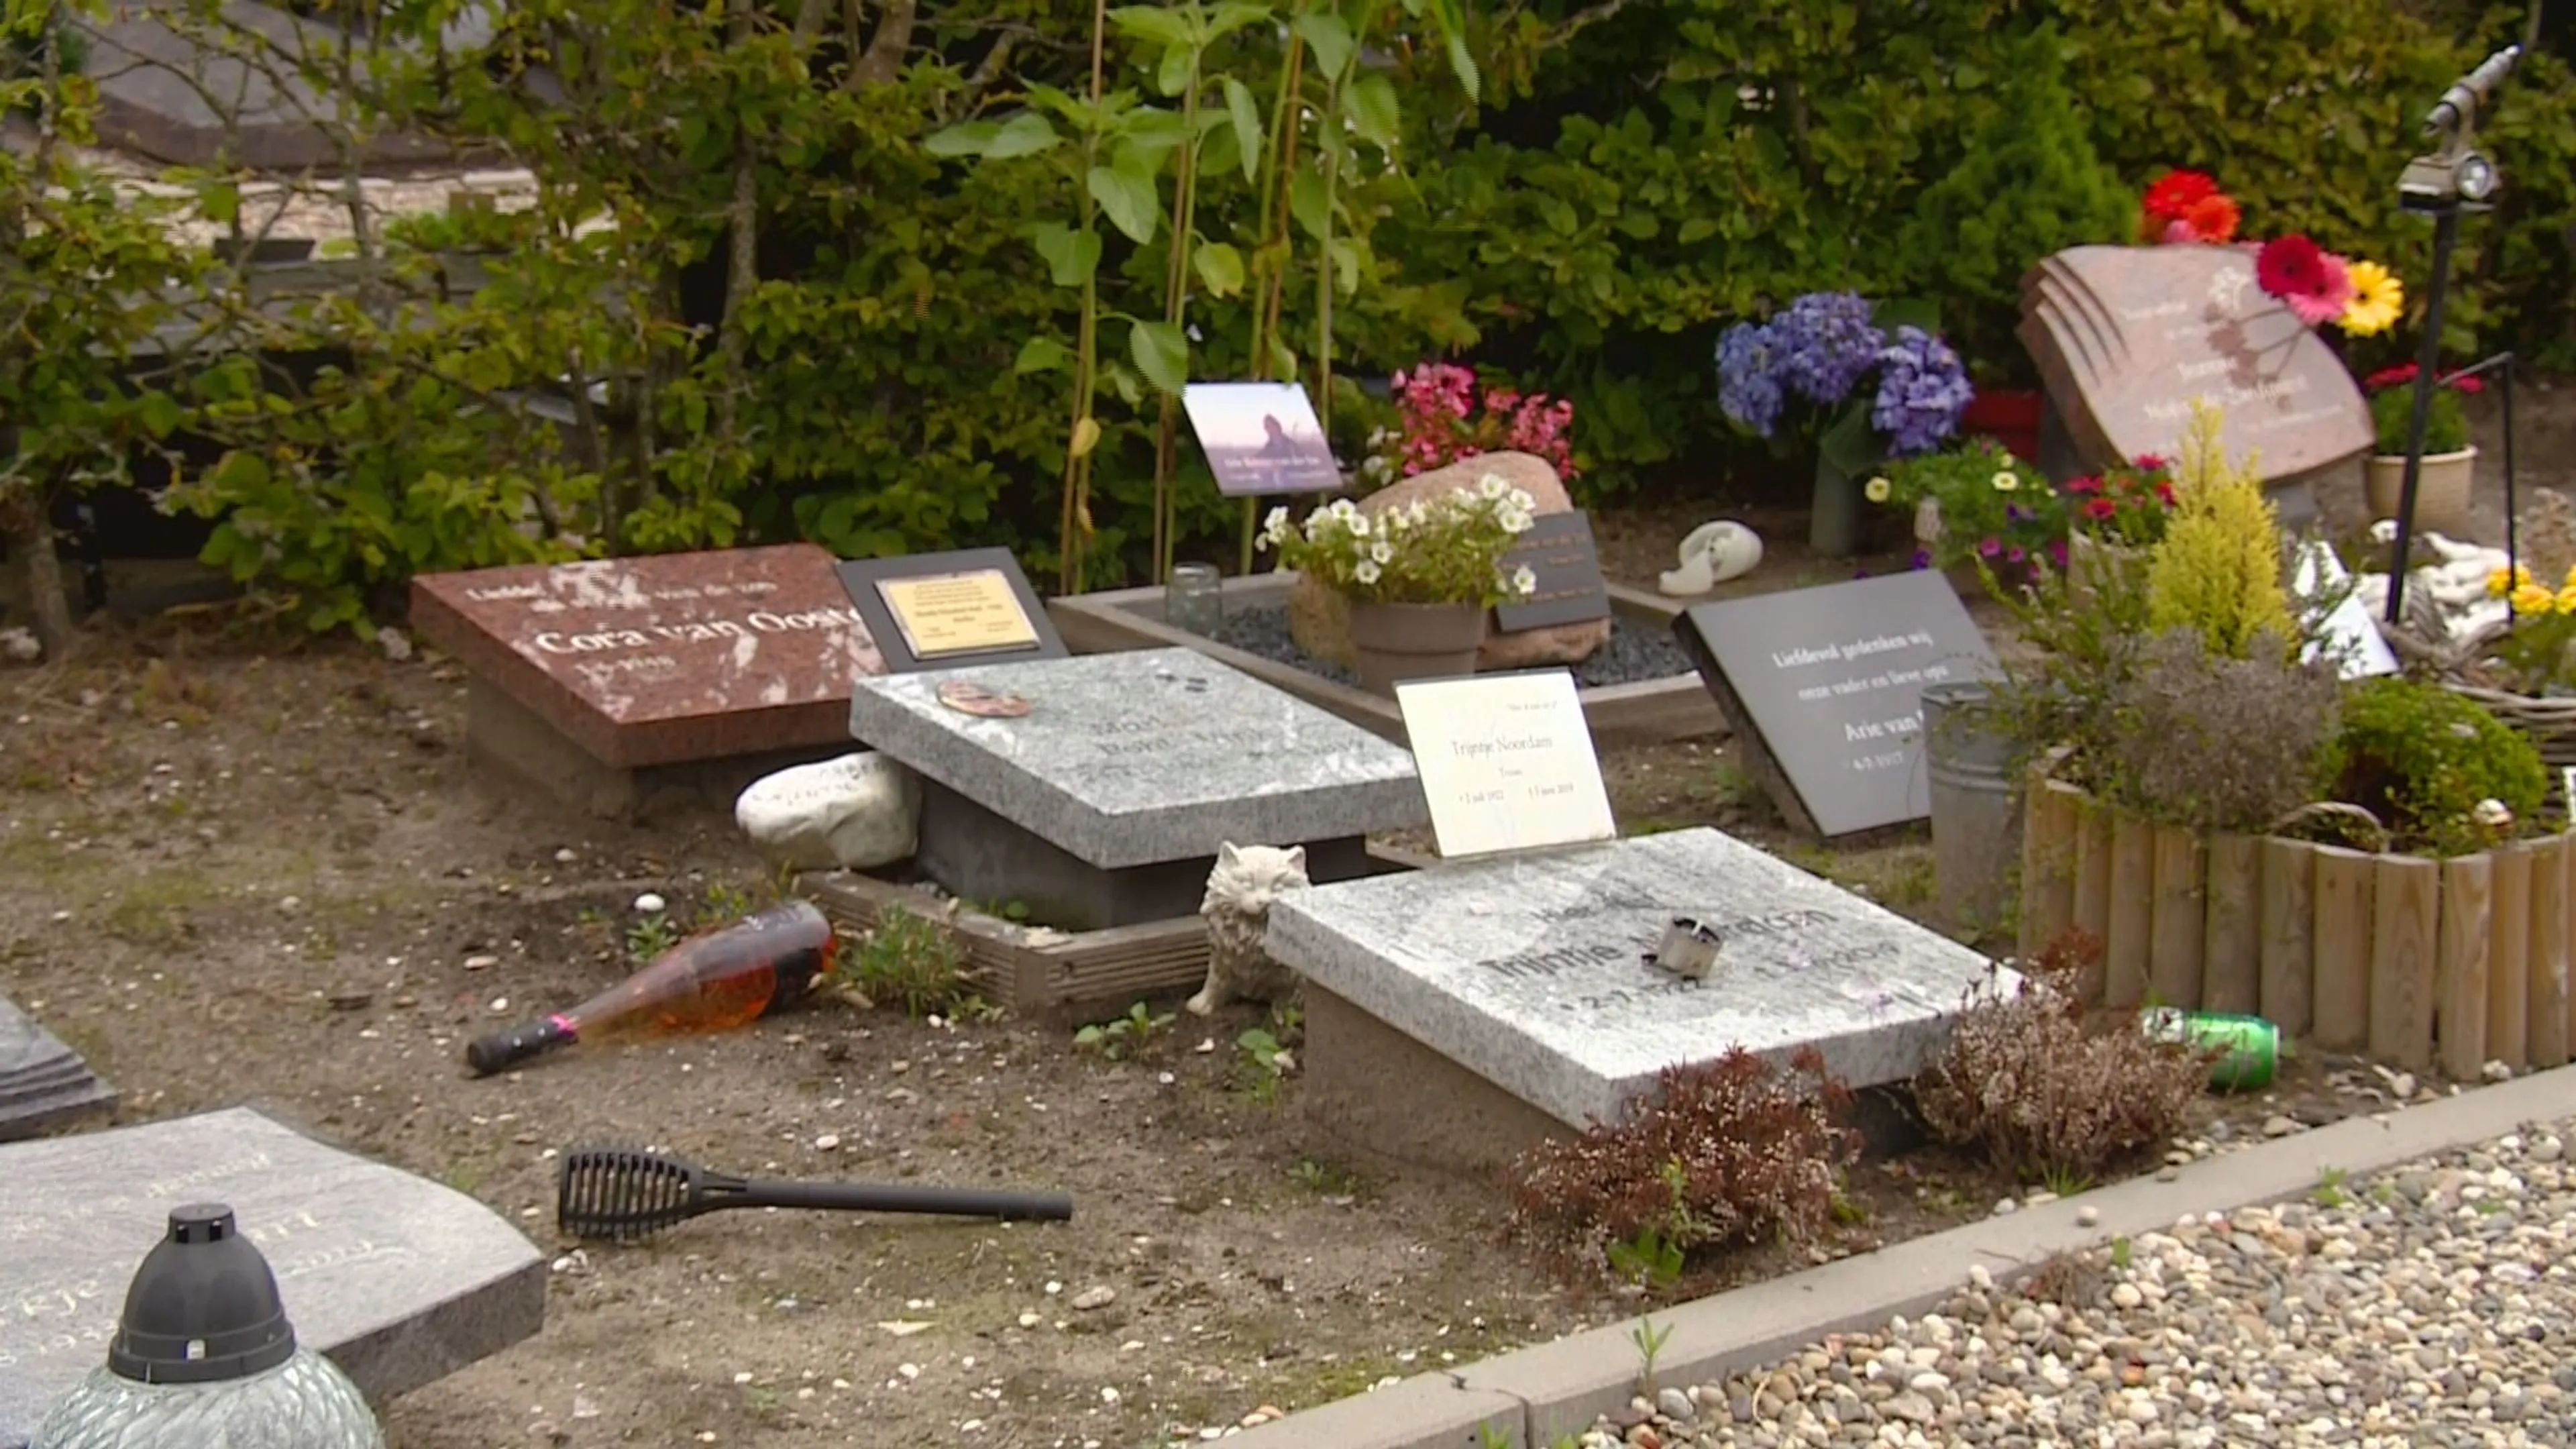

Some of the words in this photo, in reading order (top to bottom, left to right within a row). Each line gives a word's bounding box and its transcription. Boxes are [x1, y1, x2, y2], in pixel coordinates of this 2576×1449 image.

[537, 624, 648, 653] Cora
[649, 620, 743, 643] van
[1772, 642, 1840, 668] Liefdevol
[1845, 720, 1884, 742] Arie
[1884, 716, 1919, 735] van
